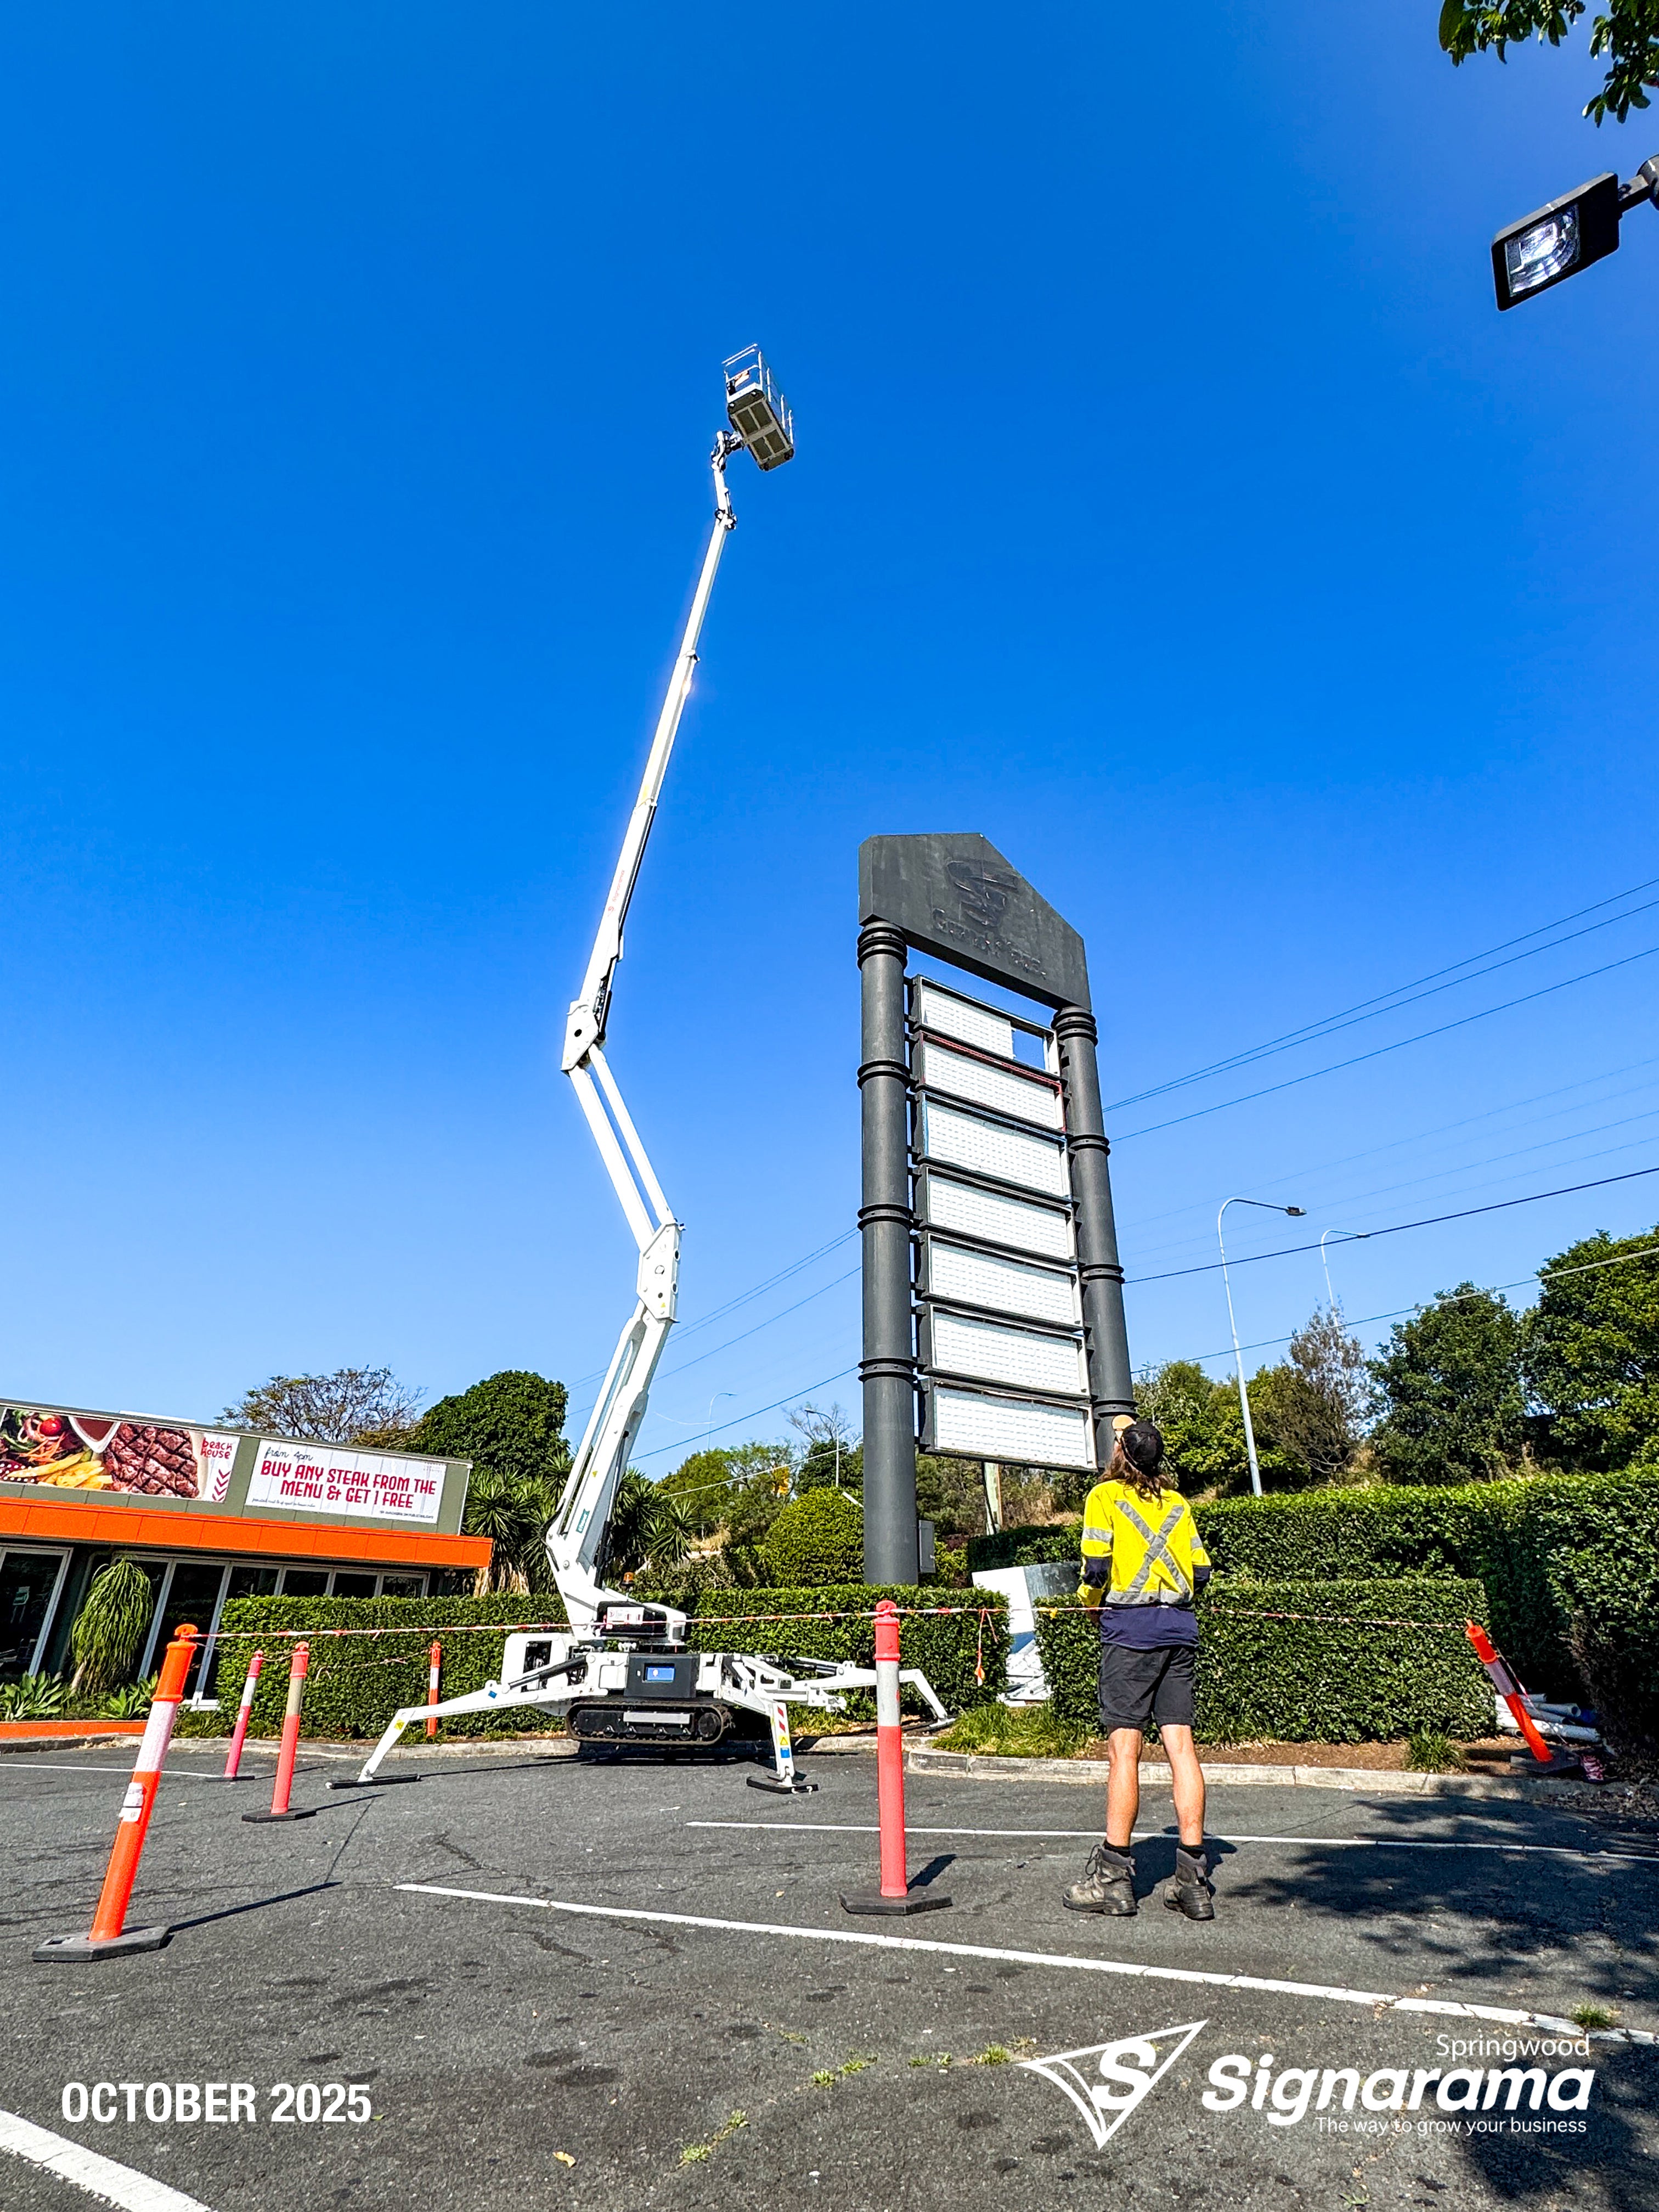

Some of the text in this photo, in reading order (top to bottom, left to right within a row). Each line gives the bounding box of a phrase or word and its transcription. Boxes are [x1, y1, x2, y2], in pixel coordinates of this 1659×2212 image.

[202, 1437, 233, 1451] beach
[200, 1448, 230, 1459] house
[294, 1451, 313, 1464] 4pm
[261, 1460, 437, 1495] BUY ANY STEAK FROM THE
[280, 1480, 323, 1499] MENU
[326, 1485, 341, 1501] &
[346, 1488, 371, 1504] GET
[382, 1491, 414, 1509] FREE
